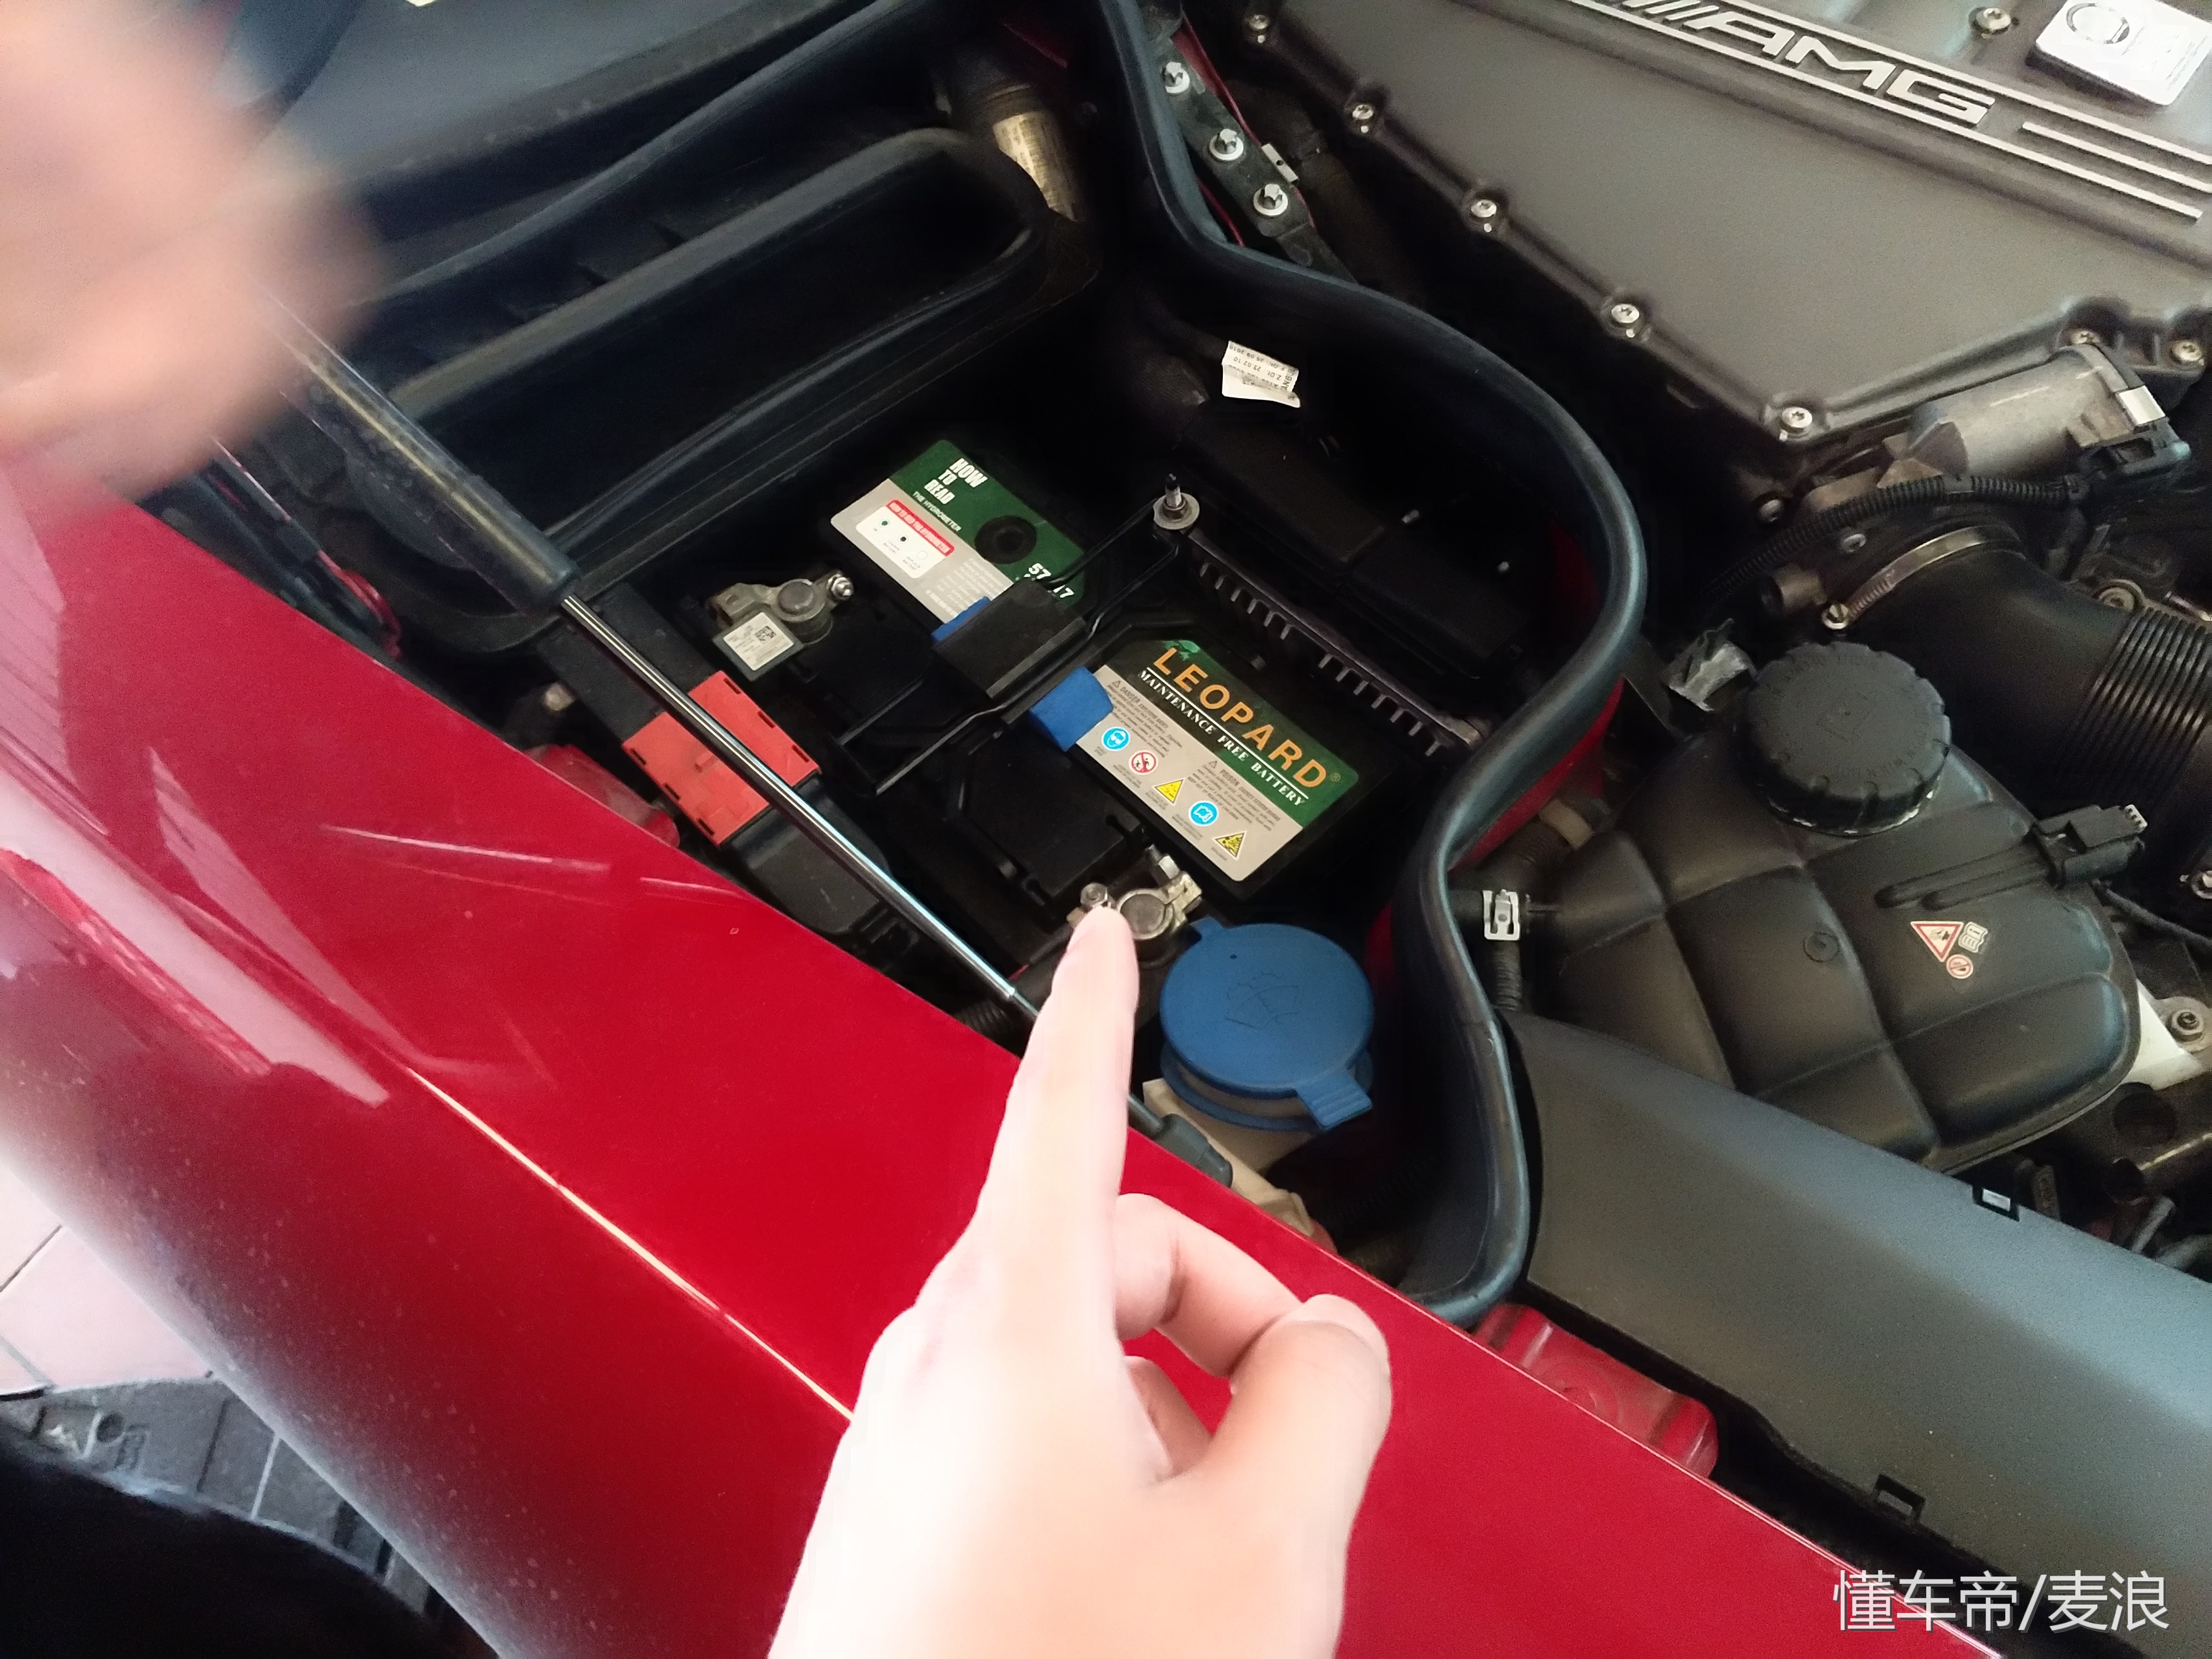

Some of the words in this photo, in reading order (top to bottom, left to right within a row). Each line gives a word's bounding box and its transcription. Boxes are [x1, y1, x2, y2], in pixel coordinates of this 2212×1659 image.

[938, 469, 957, 485] TO
[949, 458, 988, 488] HOW
[923, 479, 955, 504] READ
[912, 490, 926, 502] THE
[923, 500, 961, 532] HYDROMETER
[1120, 686, 1140, 703] DANGER
[1152, 647, 1327, 786] LEOPARD
[1137, 670, 1215, 735] MAINTENANCE
[1217, 735, 1249, 761] FREE
[1251, 762, 1306, 805] BATTERY
[1219, 769, 1240, 787] POISON
